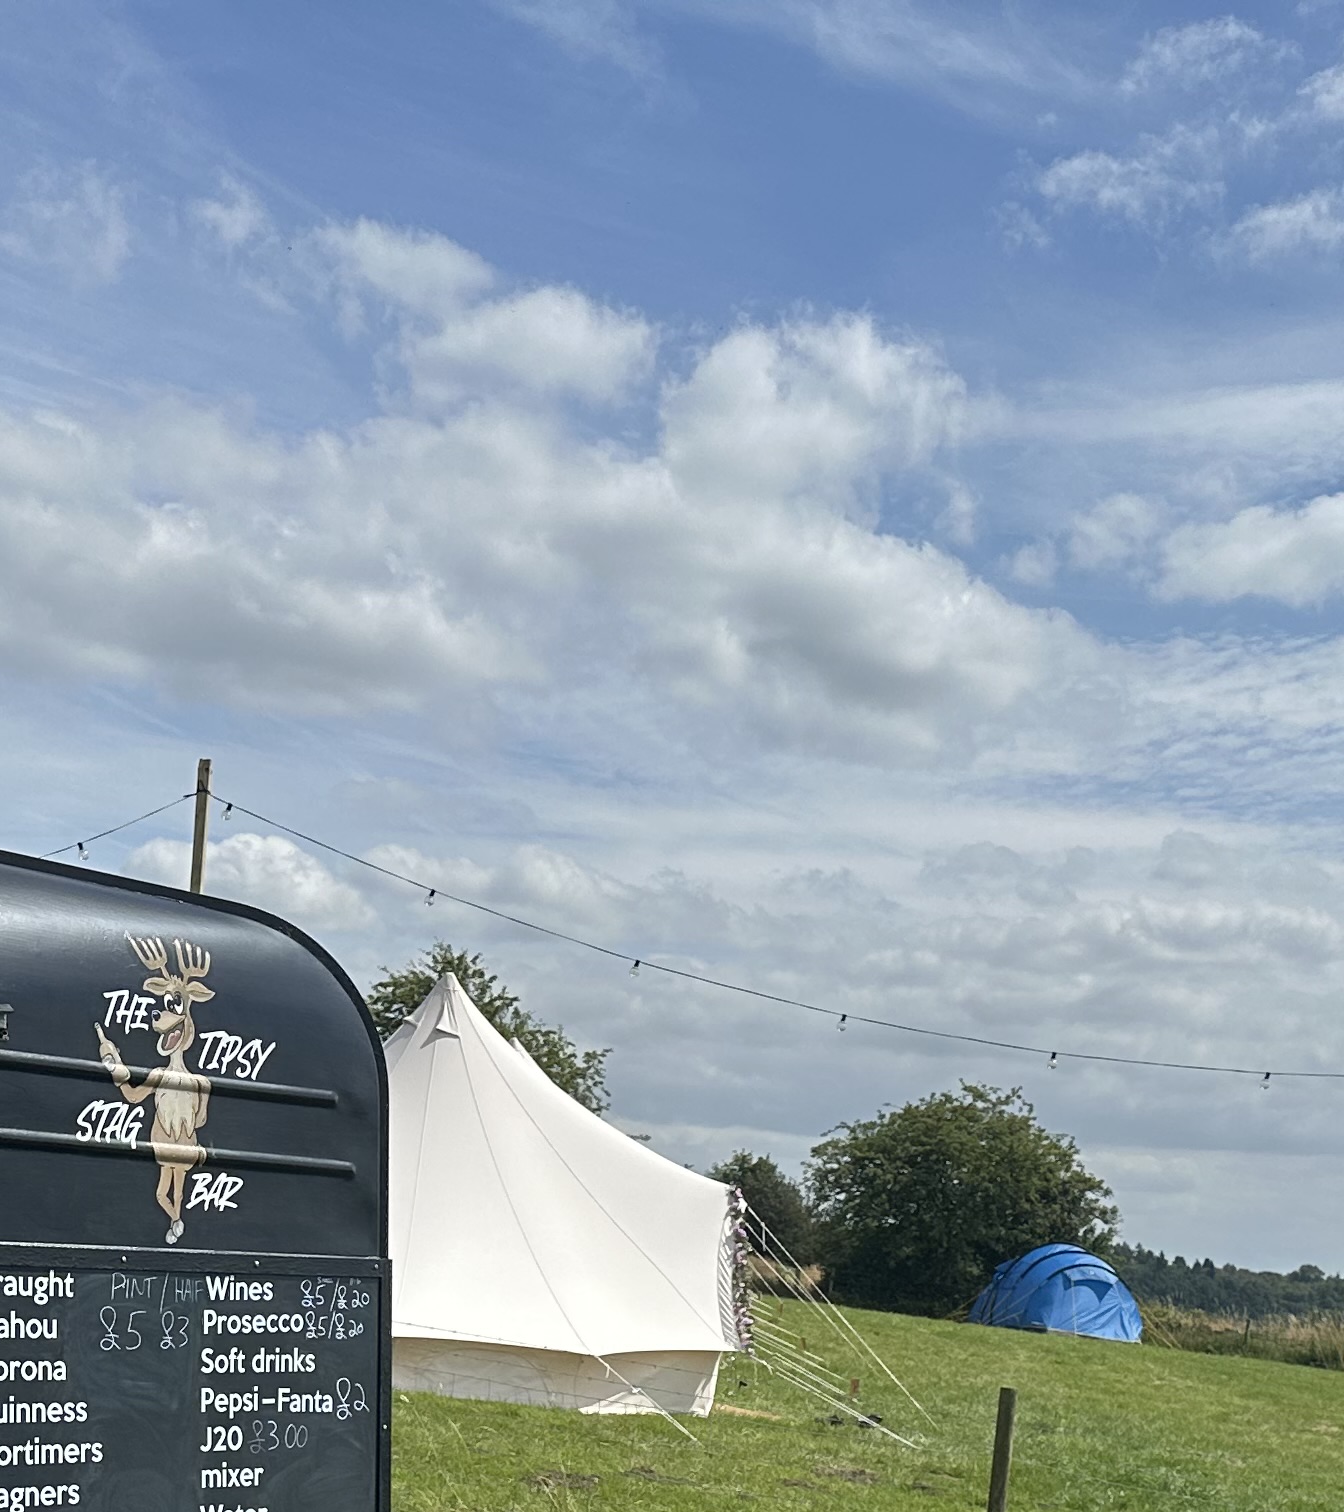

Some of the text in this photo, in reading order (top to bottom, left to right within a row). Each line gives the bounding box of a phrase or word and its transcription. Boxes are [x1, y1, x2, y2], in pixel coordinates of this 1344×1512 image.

[103, 990, 156, 1034] THE
[197, 1030, 277, 1081] TIPSY
[76, 1100, 145, 1149] STAG
[186, 1172, 244, 1211] BAR
[111, 1272, 157, 1300] PINT
[206, 1275, 274, 1302] Wines
[99, 1306, 190, 1351] £5 £3
[203, 1309, 304, 1335] Prosecco
[200, 1347, 316, 1374] Soft drinks
[336, 1377, 370, 1420] £2
[200, 1425, 243, 1452] J20
[201, 1461, 264, 1489] mixer
